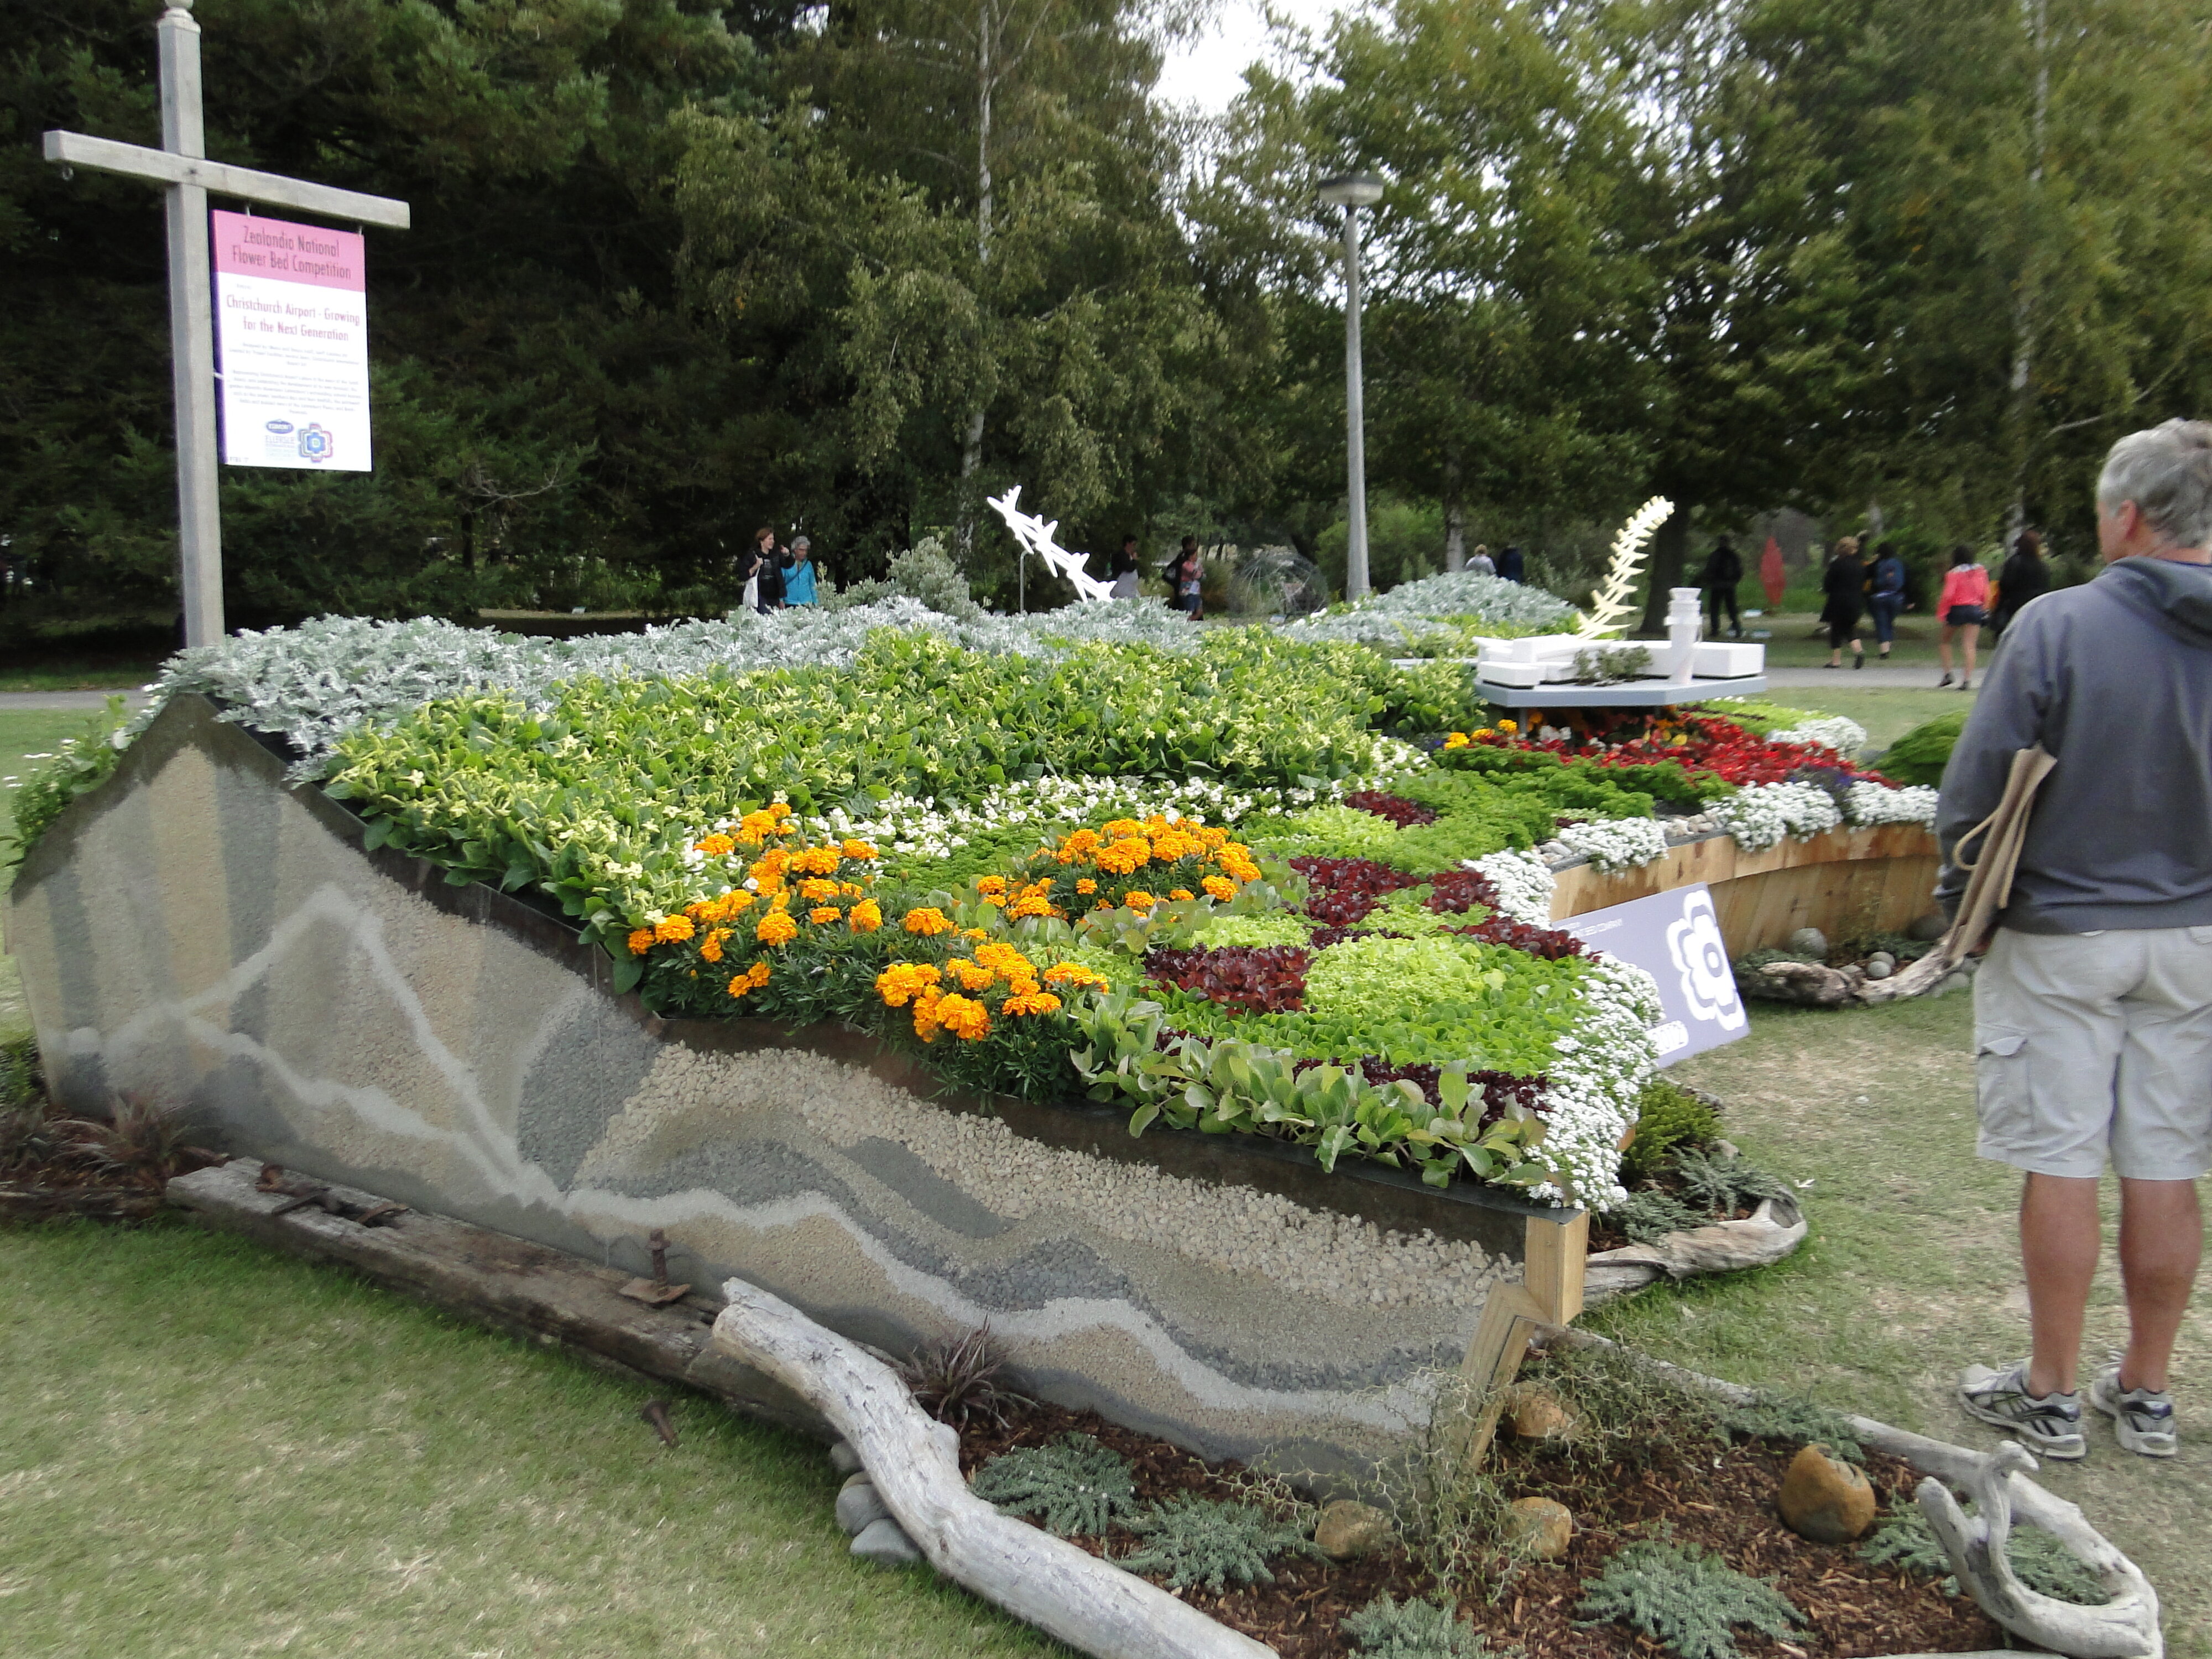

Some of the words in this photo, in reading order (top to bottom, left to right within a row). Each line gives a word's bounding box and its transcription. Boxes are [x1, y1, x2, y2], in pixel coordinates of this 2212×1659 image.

[243, 226, 294, 249] Zealandia
[298, 236, 340, 257] National
[232, 245, 266, 265] Flower
[270, 252, 289, 270] Bed
[293, 255, 351, 279] Competition
[227, 294, 282, 314] Christchurch
[286, 303, 316, 319] Airport
[325, 307, 360, 327] Growing
[243, 316, 256, 330] for
[260, 319, 274, 333] the
[278, 322, 297, 336] Next
[301, 325, 349, 341] Generation
